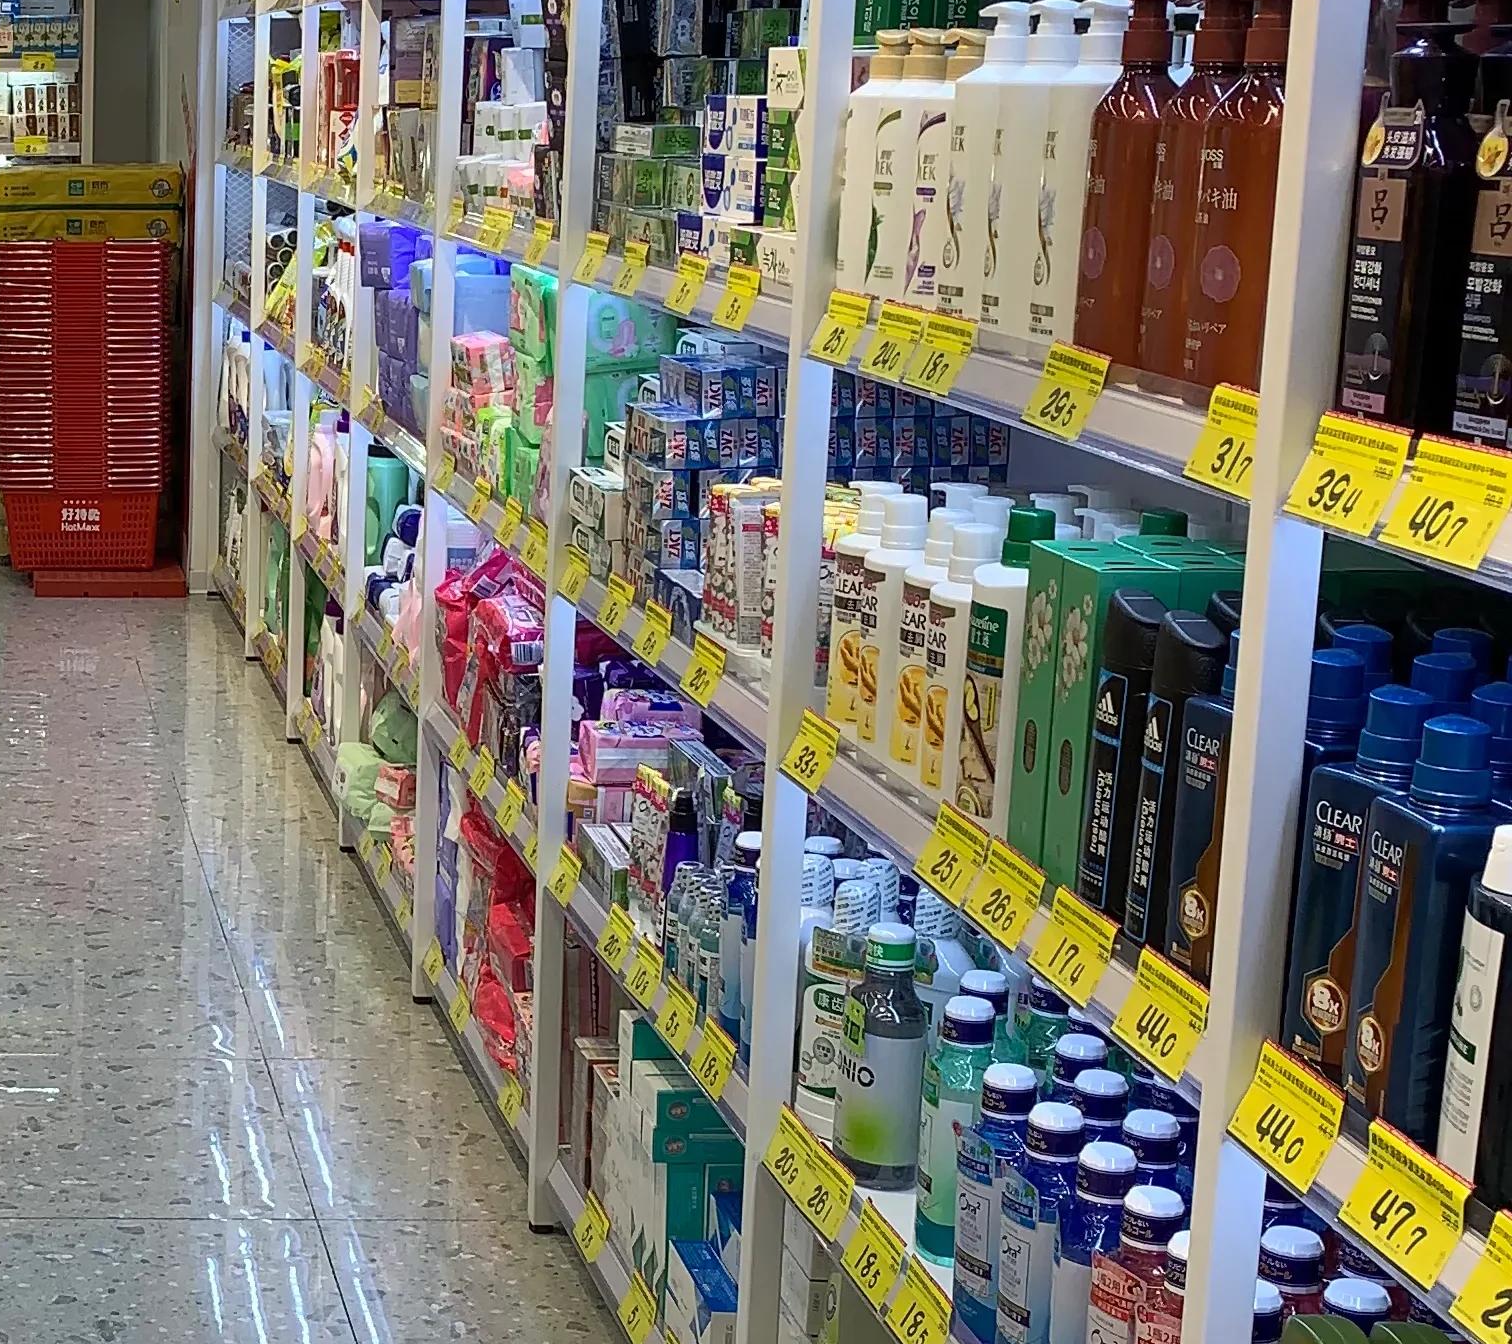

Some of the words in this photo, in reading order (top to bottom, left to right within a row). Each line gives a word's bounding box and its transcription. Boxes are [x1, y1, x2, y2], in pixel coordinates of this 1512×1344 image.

[1186, 727, 1220, 757] CLEAR
[1315, 800, 1363, 835] CLEAR
[1371, 830, 1403, 867] CLEAR
